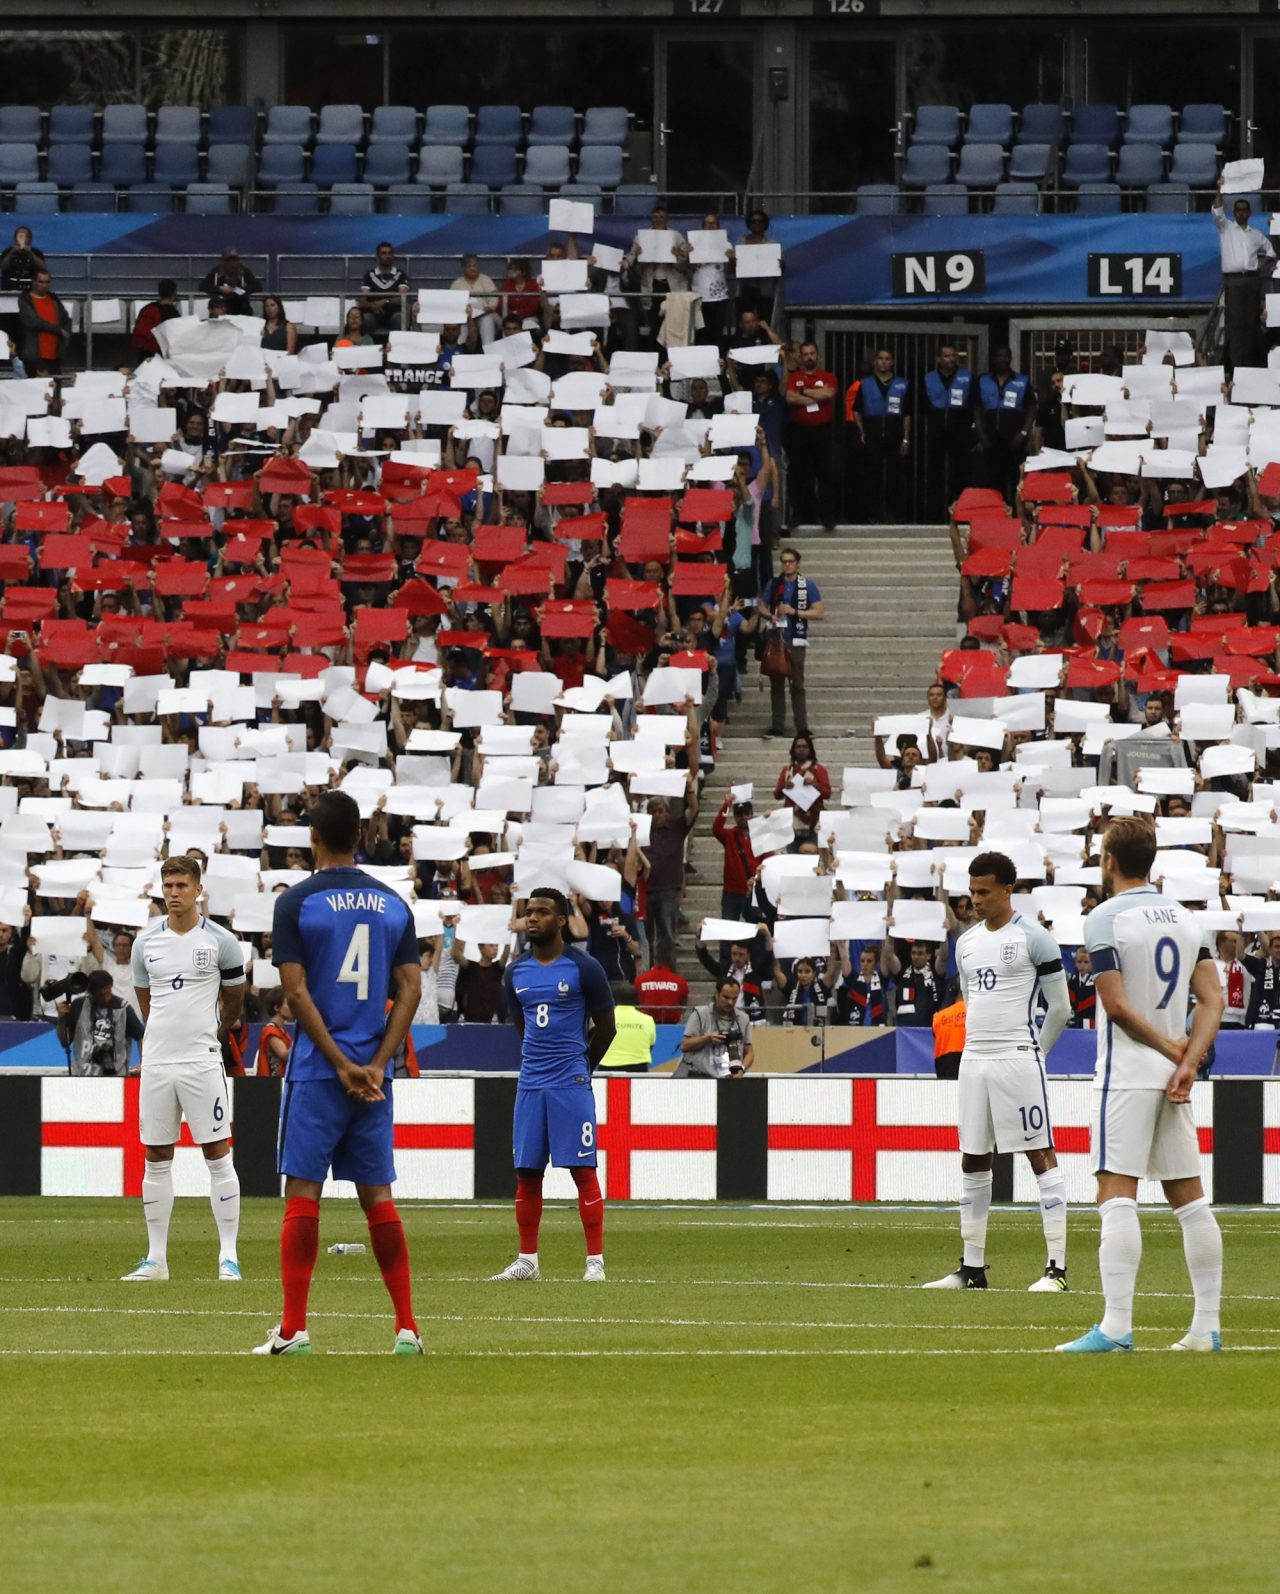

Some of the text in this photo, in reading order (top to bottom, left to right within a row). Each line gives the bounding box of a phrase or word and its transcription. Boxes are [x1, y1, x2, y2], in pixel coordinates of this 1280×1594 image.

[1100, 257, 1174, 294] L14
[325, 892, 387, 914] VARANE
[1142, 909, 1179, 925] KANE
[336, 923, 370, 1001] 4
[1154, 936, 1180, 1010] 9
[171, 973, 185, 991] 6
[641, 981, 678, 992] STEWARD
[976, 968, 998, 991] 10
[536, 1003, 549, 1028] 8
[213, 1096, 224, 1122] 6
[1018, 1105, 1044, 1131] 10
[581, 1121, 594, 1148] 8
